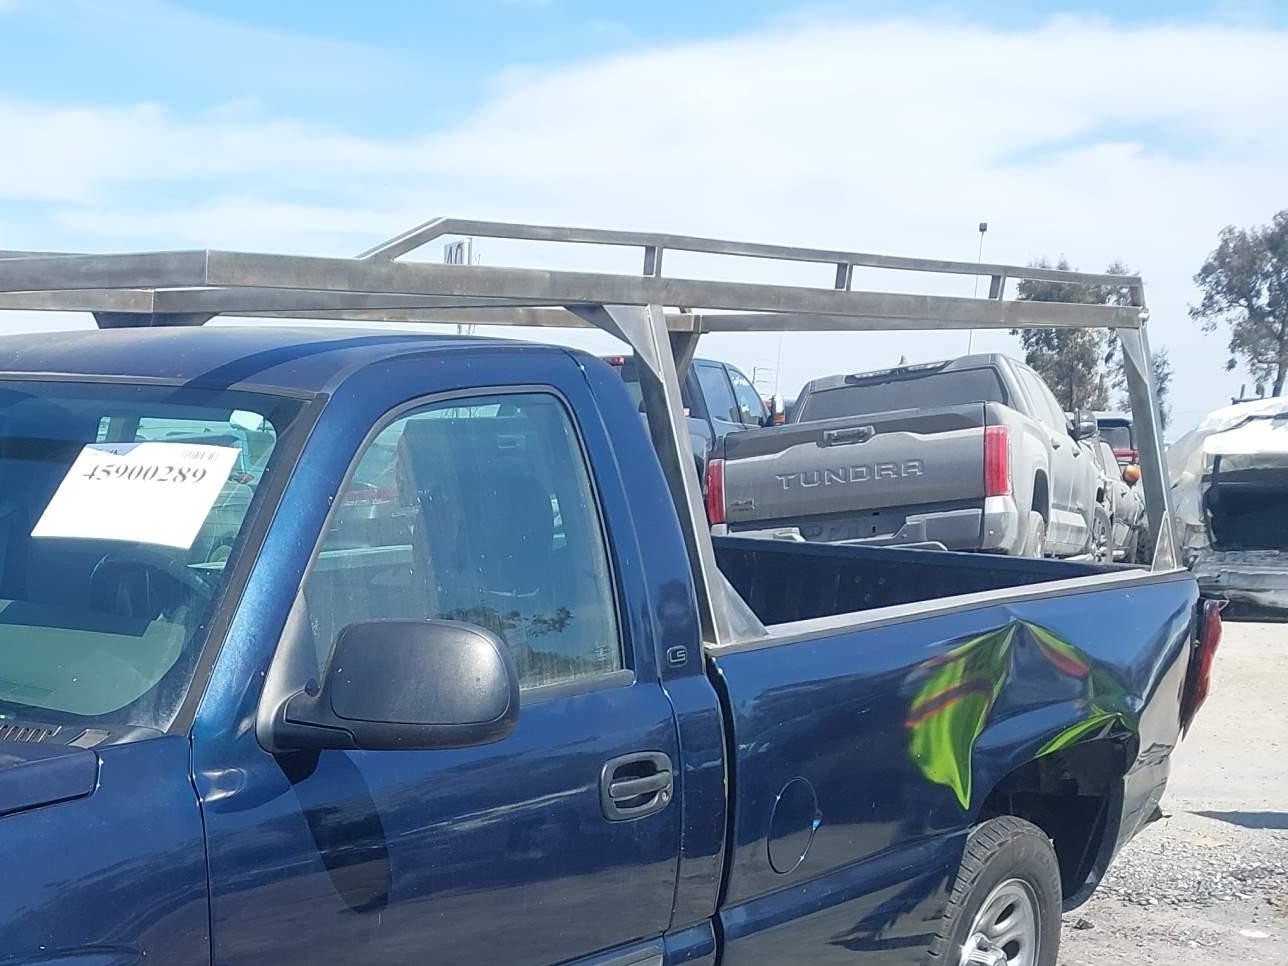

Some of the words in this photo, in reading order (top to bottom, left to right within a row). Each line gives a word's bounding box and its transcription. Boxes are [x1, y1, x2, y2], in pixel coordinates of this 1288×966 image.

[82, 463, 208, 483] 45900289
[775, 459, 925, 490] TUNDRA
[669, 649, 686, 663] LS
